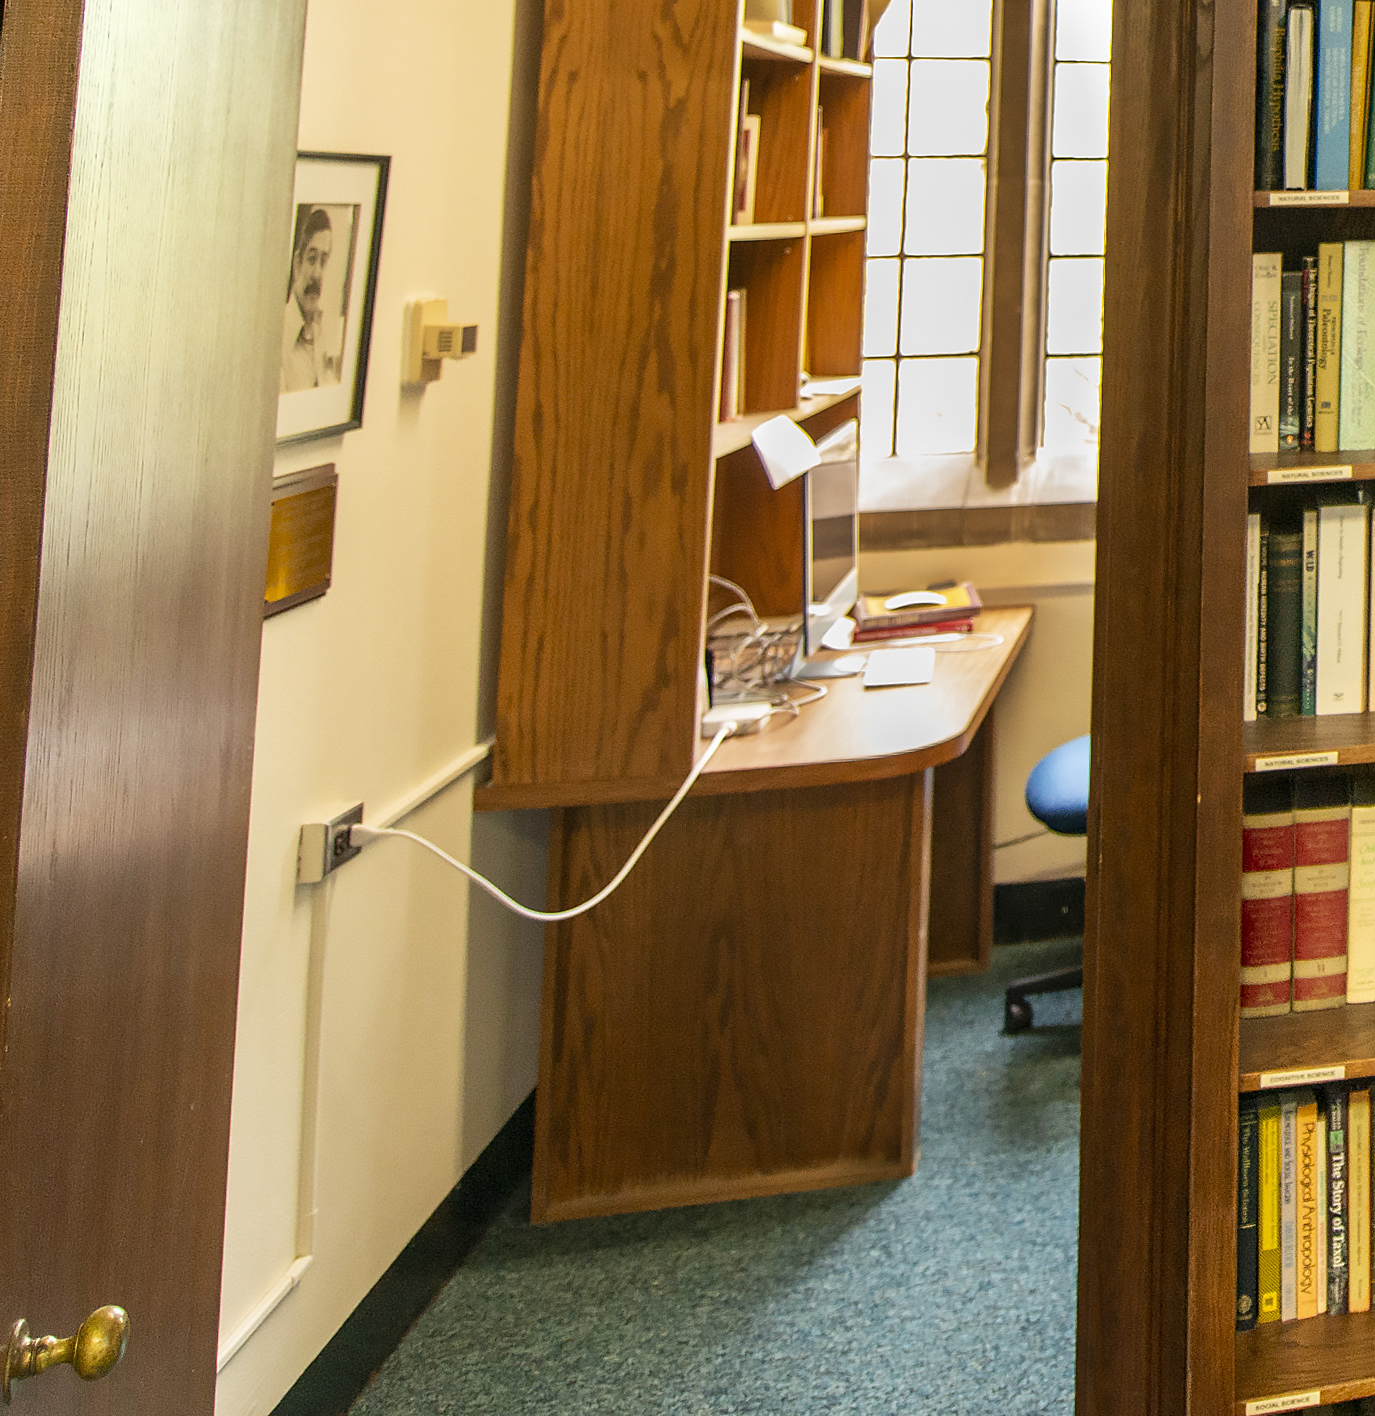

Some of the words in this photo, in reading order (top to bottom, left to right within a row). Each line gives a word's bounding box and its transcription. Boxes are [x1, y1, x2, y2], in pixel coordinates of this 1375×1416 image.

[1318, 309, 1331, 370] Paleontology
[1300, 1123, 1317, 1200] Physiological
[1331, 1154, 1344, 1177] The
[1330, 1181, 1344, 1216] Story
[1331, 1220, 1345, 1231] of
[1300, 1203, 1315, 1293] Anthropology
[1332, 1234, 1346, 1267] Taxol
